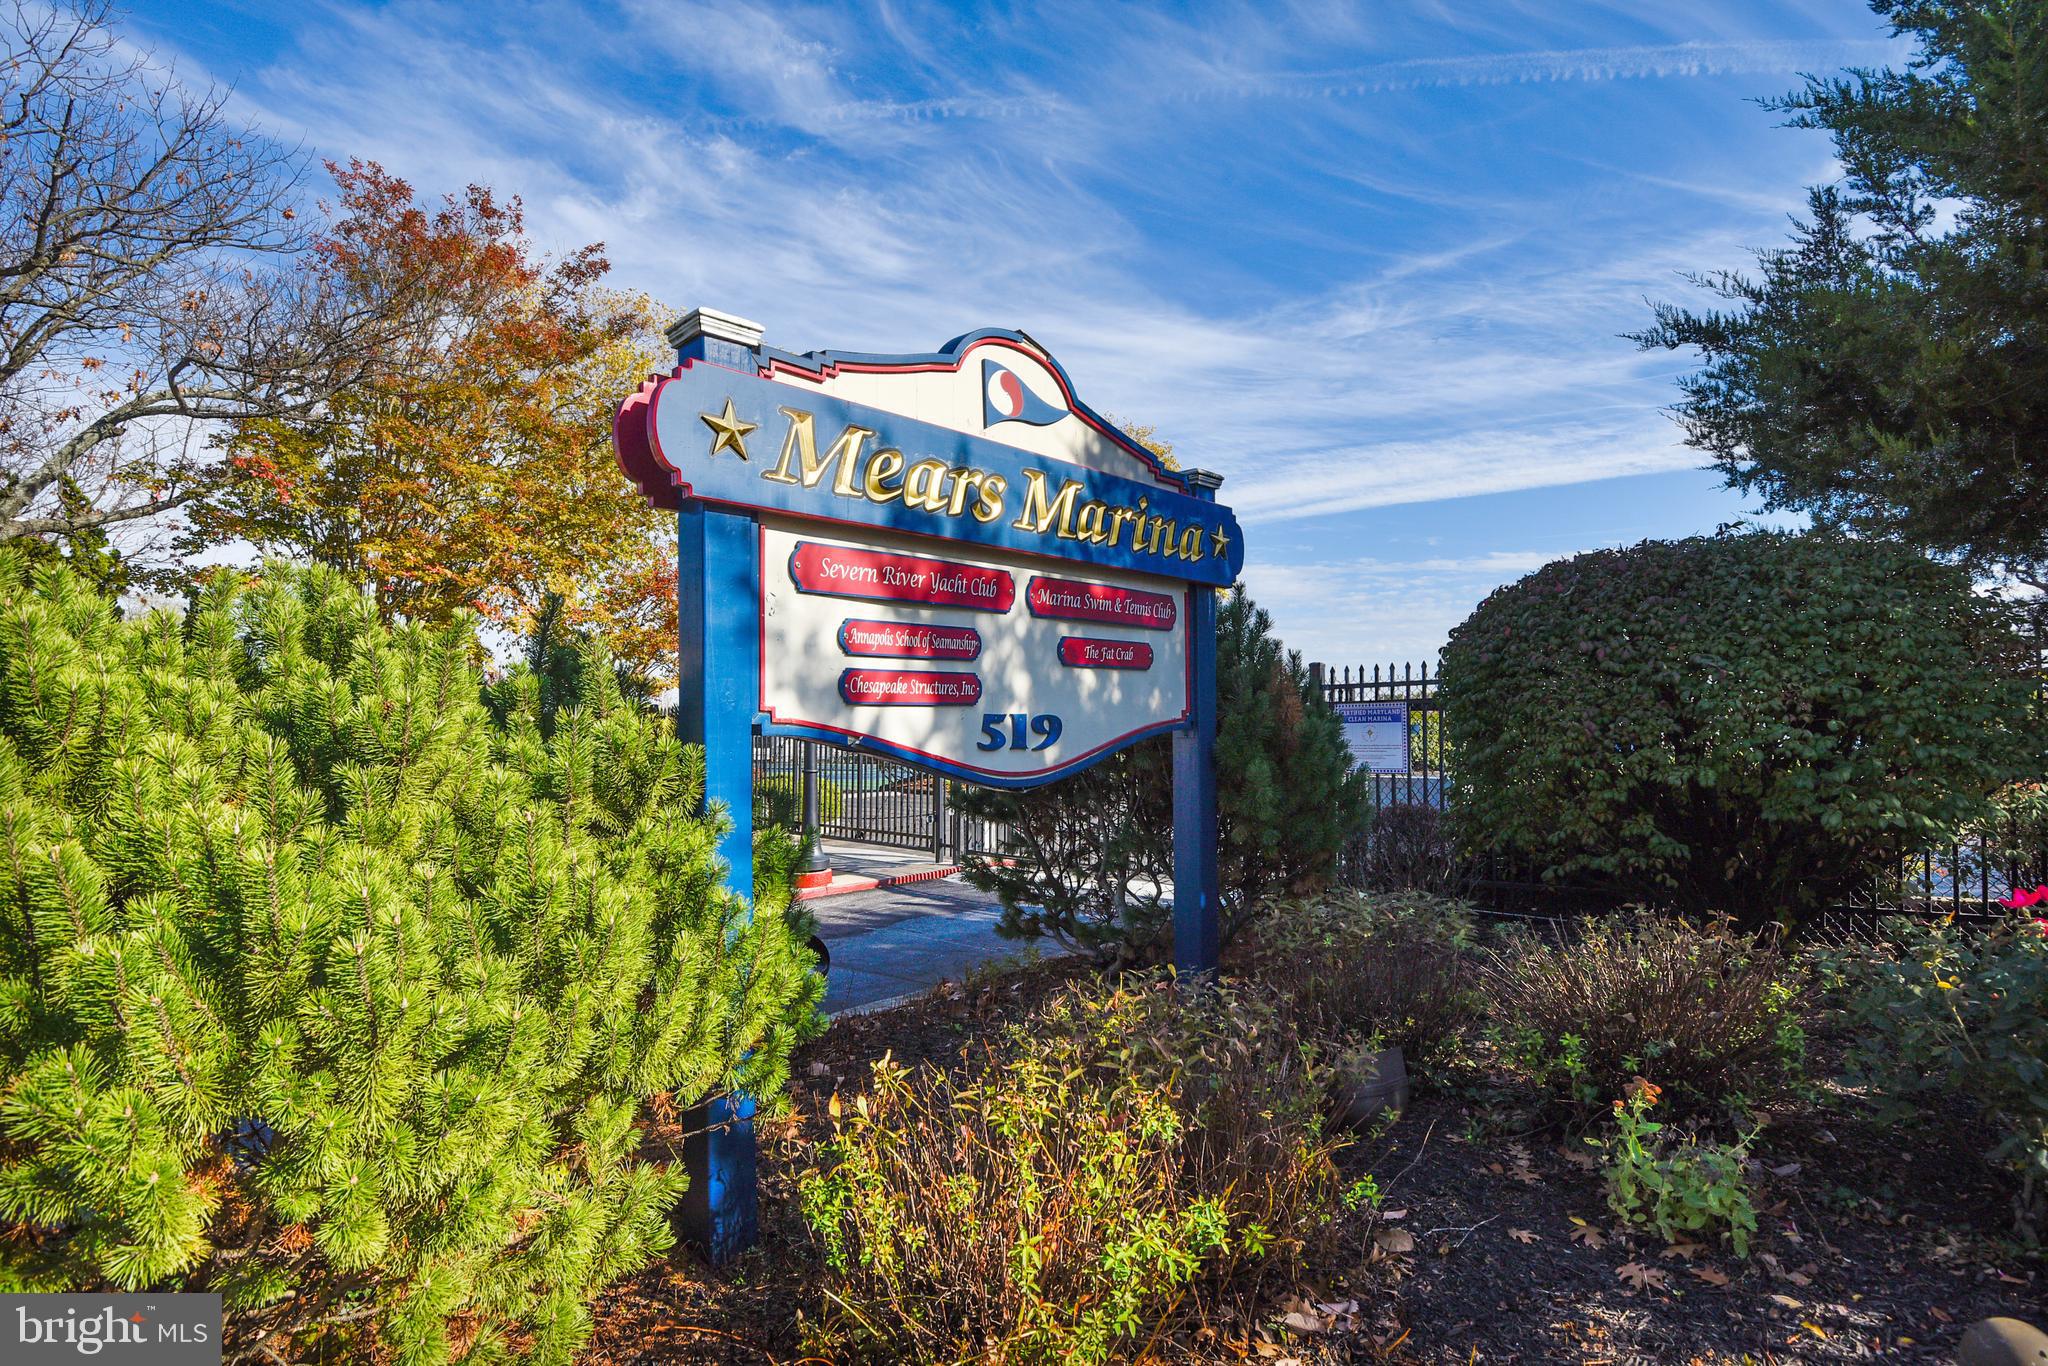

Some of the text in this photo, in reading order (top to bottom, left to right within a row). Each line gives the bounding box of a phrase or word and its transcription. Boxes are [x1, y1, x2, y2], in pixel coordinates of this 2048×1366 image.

[761, 405, 1206, 563] Mears Marina
[820, 557, 997, 598] Severn River Yacht Club
[1036, 588, 1171, 619] Marina Swim & Tennis Club
[848, 628, 976, 655] Annapolis School of Seamanship
[1084, 646, 1134, 661] The Fat Crab
[850, 676, 908, 699] Chesapeake
[909, 679, 959, 697] Structures,
[976, 713, 1063, 751] 519
